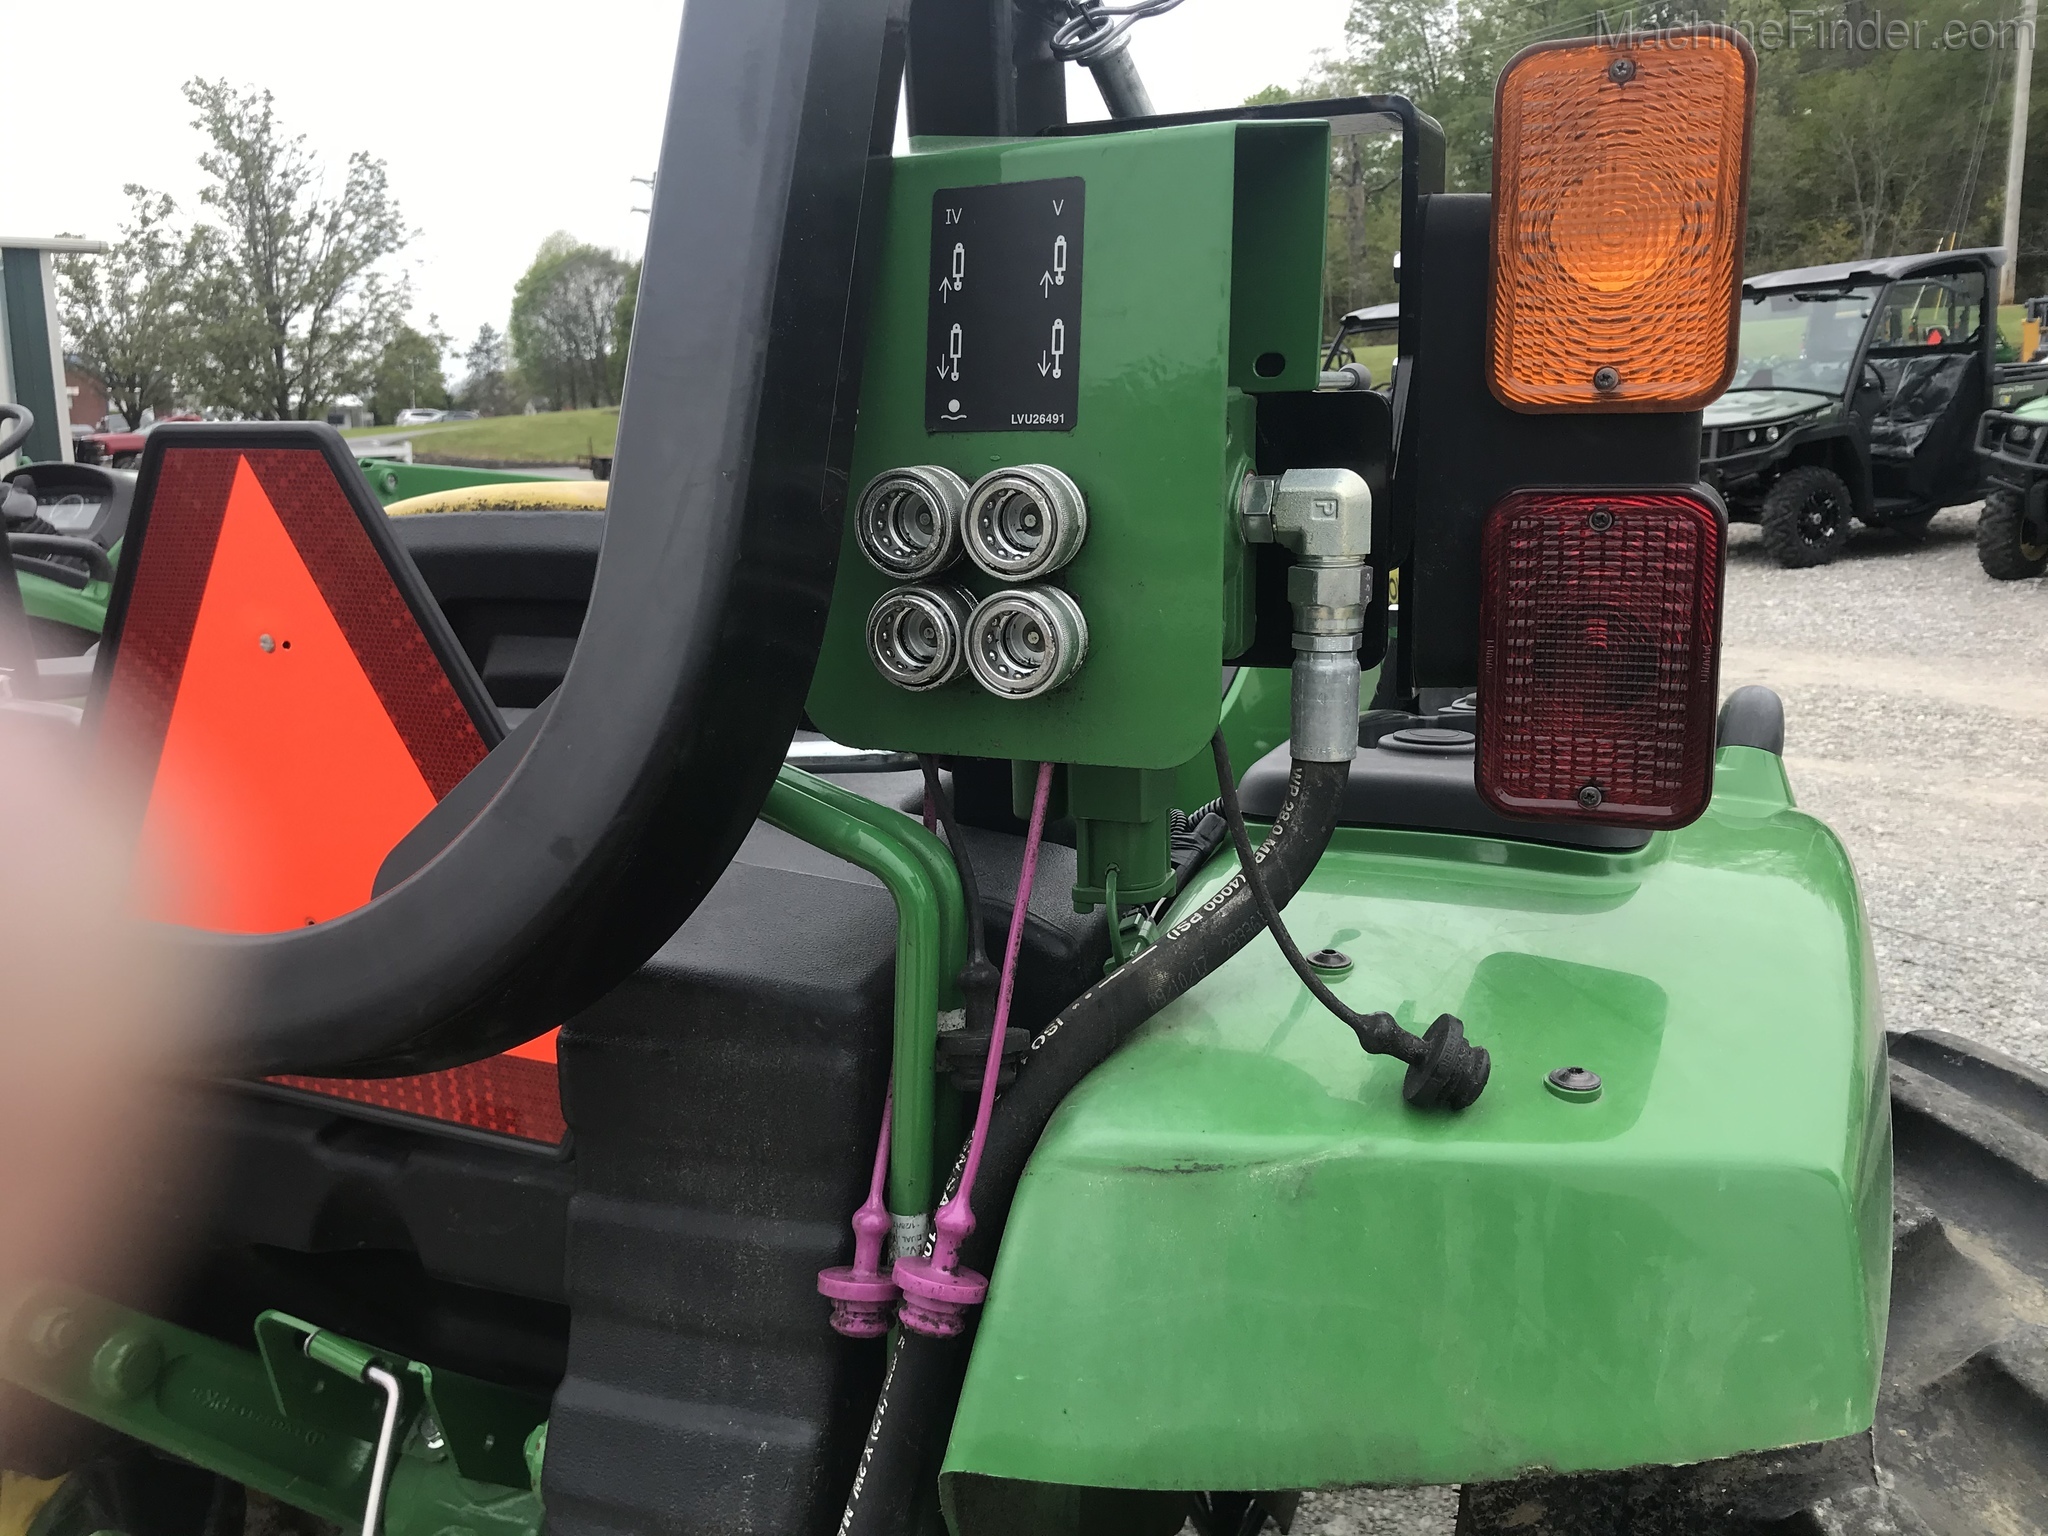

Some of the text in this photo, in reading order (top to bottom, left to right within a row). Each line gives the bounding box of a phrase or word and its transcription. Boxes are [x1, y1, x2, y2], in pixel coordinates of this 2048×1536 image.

[945, 208, 962, 225] IV
[1053, 199, 1064, 216] V
[1011, 413, 1065, 424] LVU26491
[1289, 767, 1303, 797] WP
[1203, 874, 1247, 911] (4000
[1166, 912, 1203, 940] PSI)
[1030, 1017, 1064, 1051] ISO
